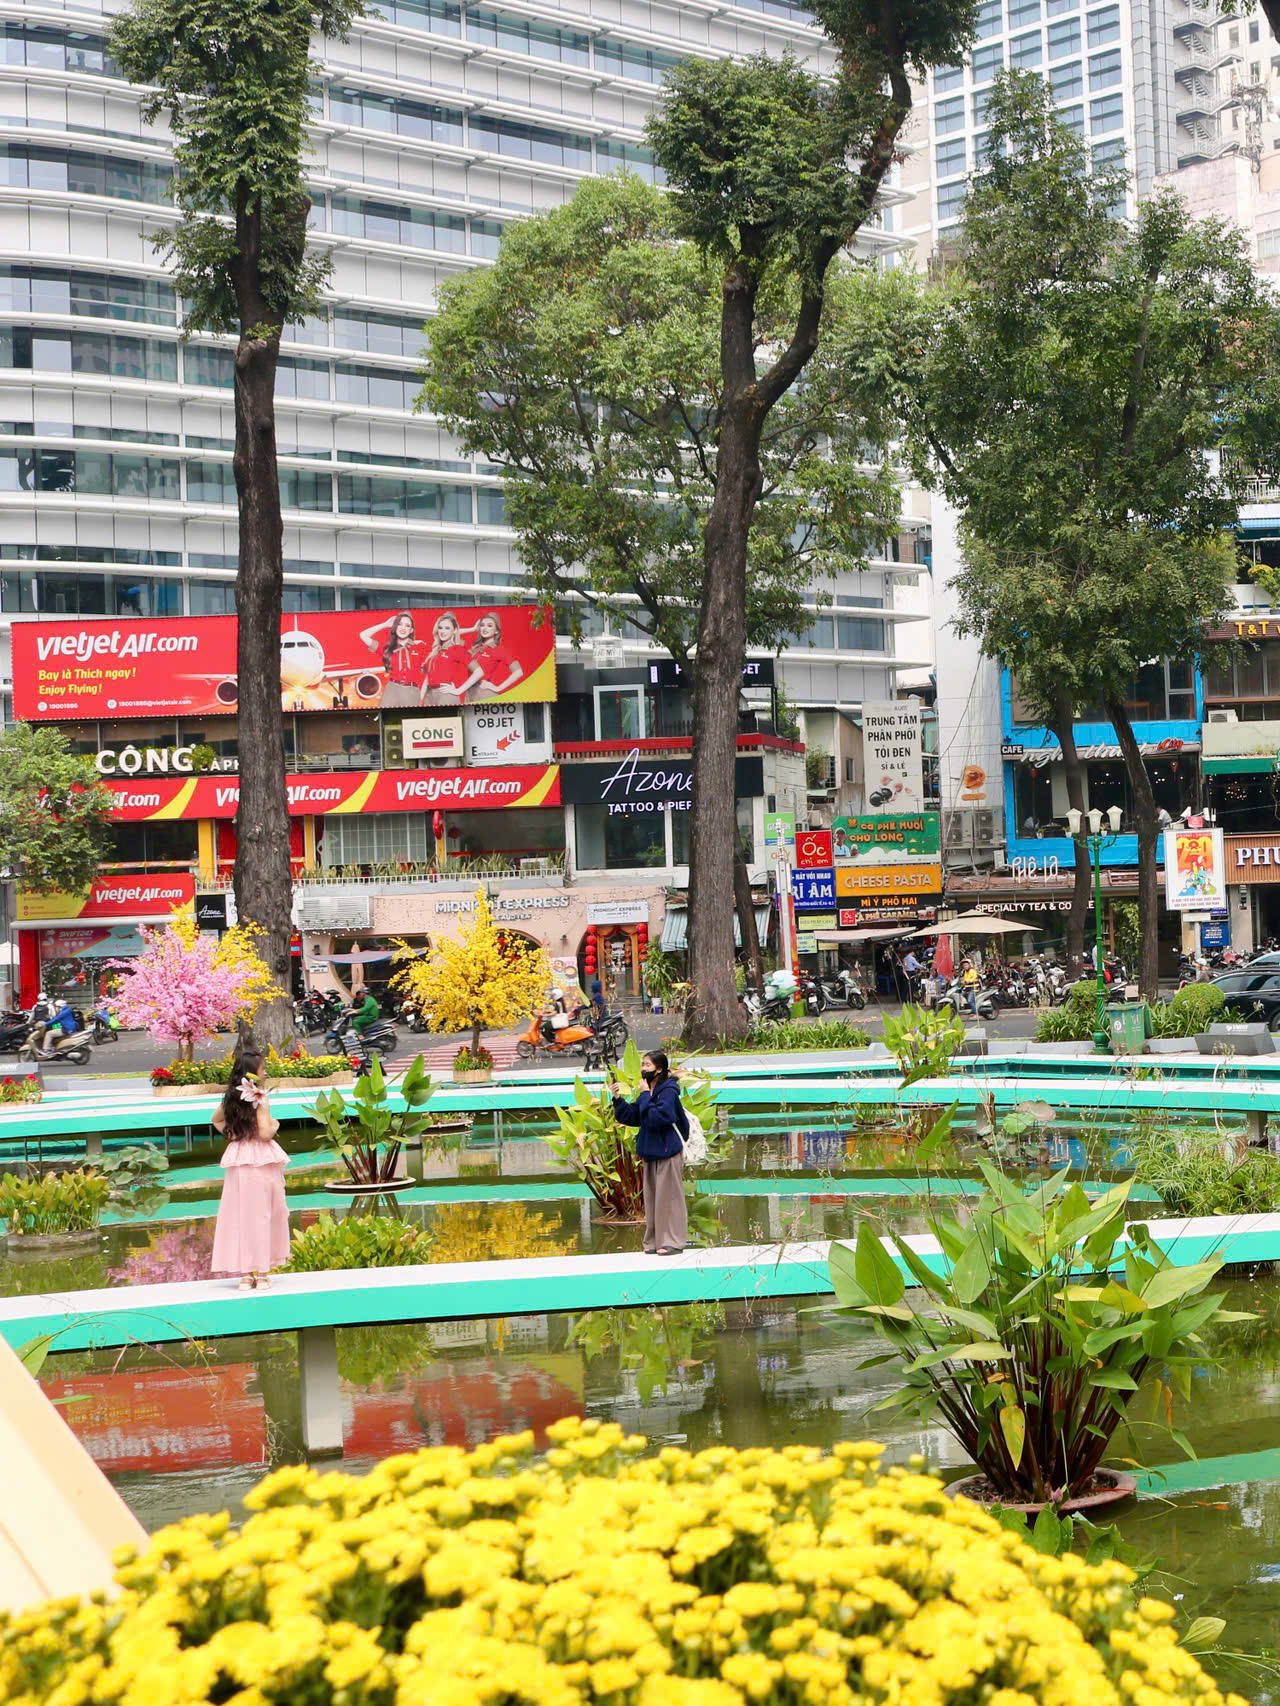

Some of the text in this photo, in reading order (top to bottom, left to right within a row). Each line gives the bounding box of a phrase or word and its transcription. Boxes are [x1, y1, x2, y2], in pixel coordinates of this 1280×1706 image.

[38, 669, 59, 682] Bay
[39, 684, 66, 696] Enjoy
[474, 703, 517, 716] PHOTO
[477, 717, 515, 729] OBJET
[865, 713, 918, 726] TRUNG TÂM
[867, 729, 892, 742] PHÂN
[1002, 745, 1023, 754] CAFE
[608, 802, 654, 814] TATTOO
[657, 802, 665, 811] &
[874, 832, 904, 842] LONG
[844, 873, 933, 889] CHEESE PASTA
[505, 896, 569, 911] EXPRESS
[901, 896, 917, 905] MAI
[975, 903, 1026, 914] SPECIALTY
[1028, 902, 1047, 912] TEA
[1049, 902, 1057, 911] &
